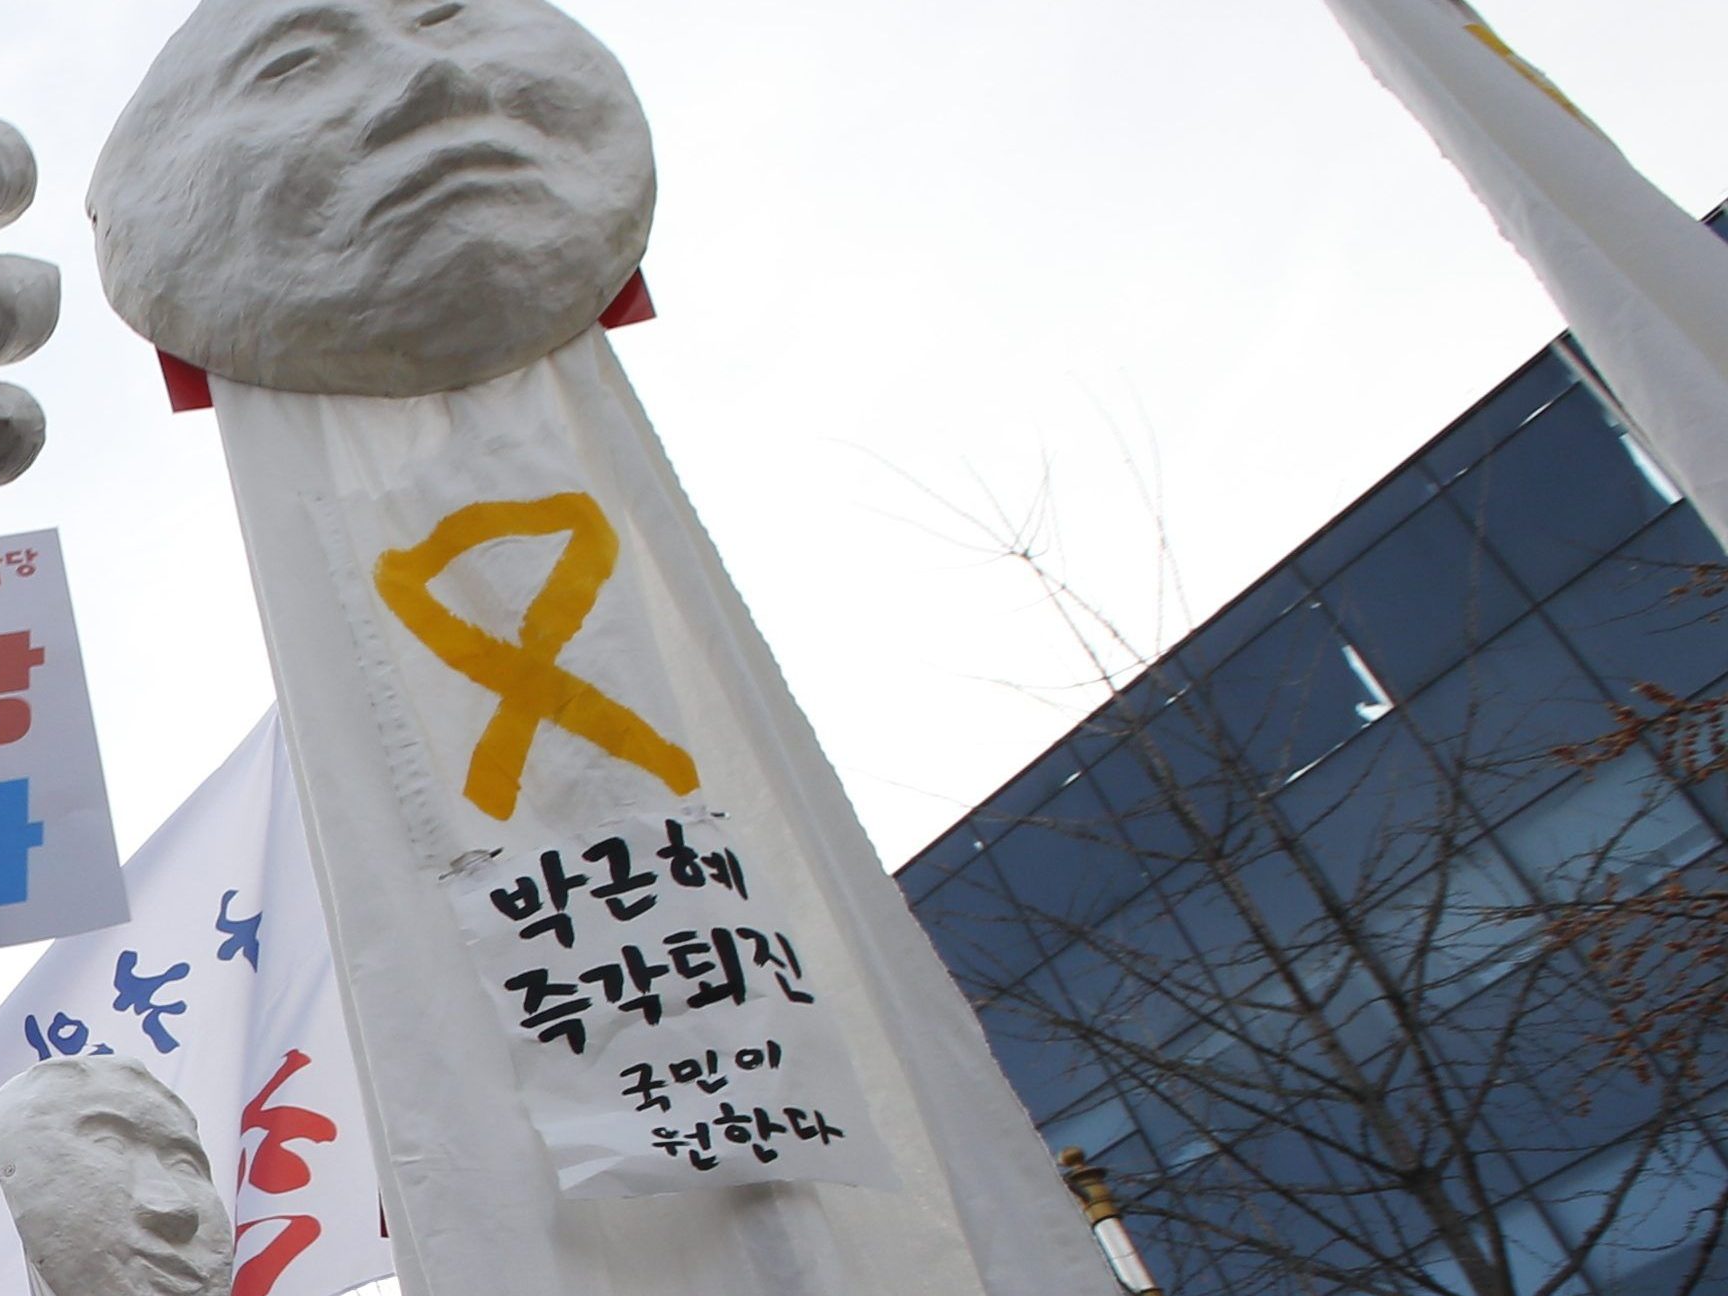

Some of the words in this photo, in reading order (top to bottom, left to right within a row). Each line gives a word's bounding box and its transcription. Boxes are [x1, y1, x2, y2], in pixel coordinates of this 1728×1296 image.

[490, 818, 749, 948] 박근혜
[503, 927, 815, 1054] 즉각퇴진
[620, 1040, 782, 1112] 국민이
[652, 1102, 845, 1170] 원한다
